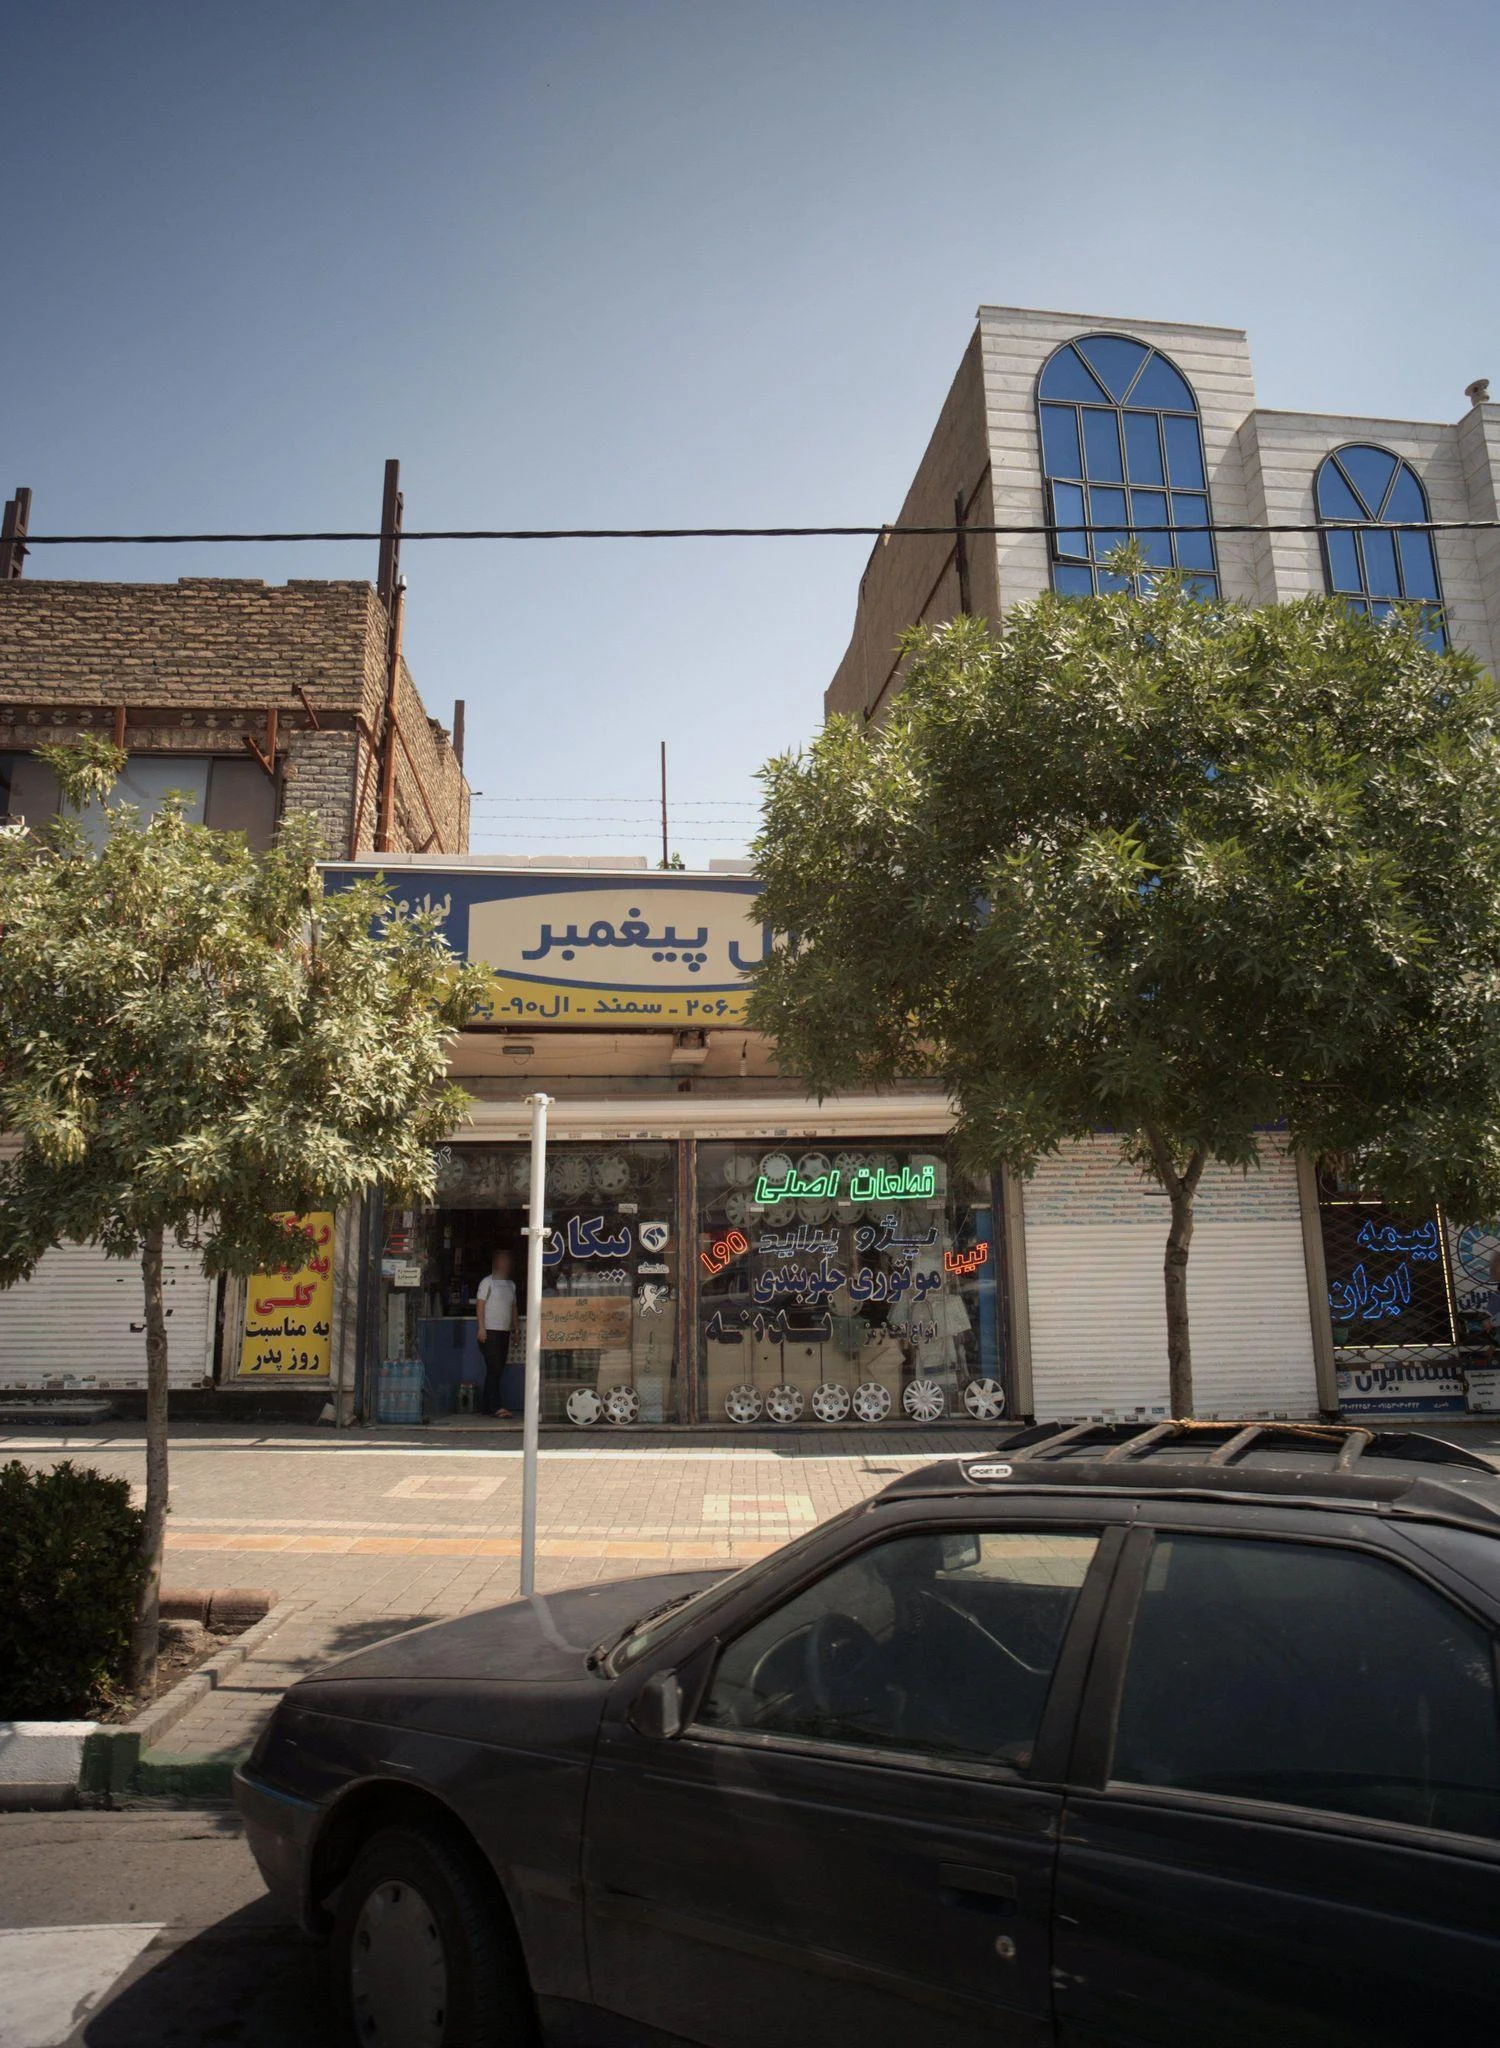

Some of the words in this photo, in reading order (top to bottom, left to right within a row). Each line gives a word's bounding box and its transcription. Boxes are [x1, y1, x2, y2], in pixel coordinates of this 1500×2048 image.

[522, 907, 708, 972] پیغمبر
[594, 997, 662, 1014] سمند
[755, 1170, 840, 1203] اصلی
[851, 1166, 934, 1200] قطعات
[700, 1231, 748, 1274] L90
[758, 1225, 840, 1259] پراید
[854, 1215, 938, 1259] پژو
[1357, 1219, 1438, 1261] بیمه
[944, 1243, 989, 1274] تیبا
[752, 1257, 847, 1304] جلوبندی
[849, 1259, 942, 1301] موتوری
[1328, 1262, 1411, 1320] ایران
[255, 1281, 318, 1316] کلی
[245, 1316, 307, 1343] مناسبت
[312, 1319, 331, 1342] به
[908, 1320, 939, 1346] انواع
[250, 1347, 283, 1372] پدر
[287, 1347, 320, 1371] روز
